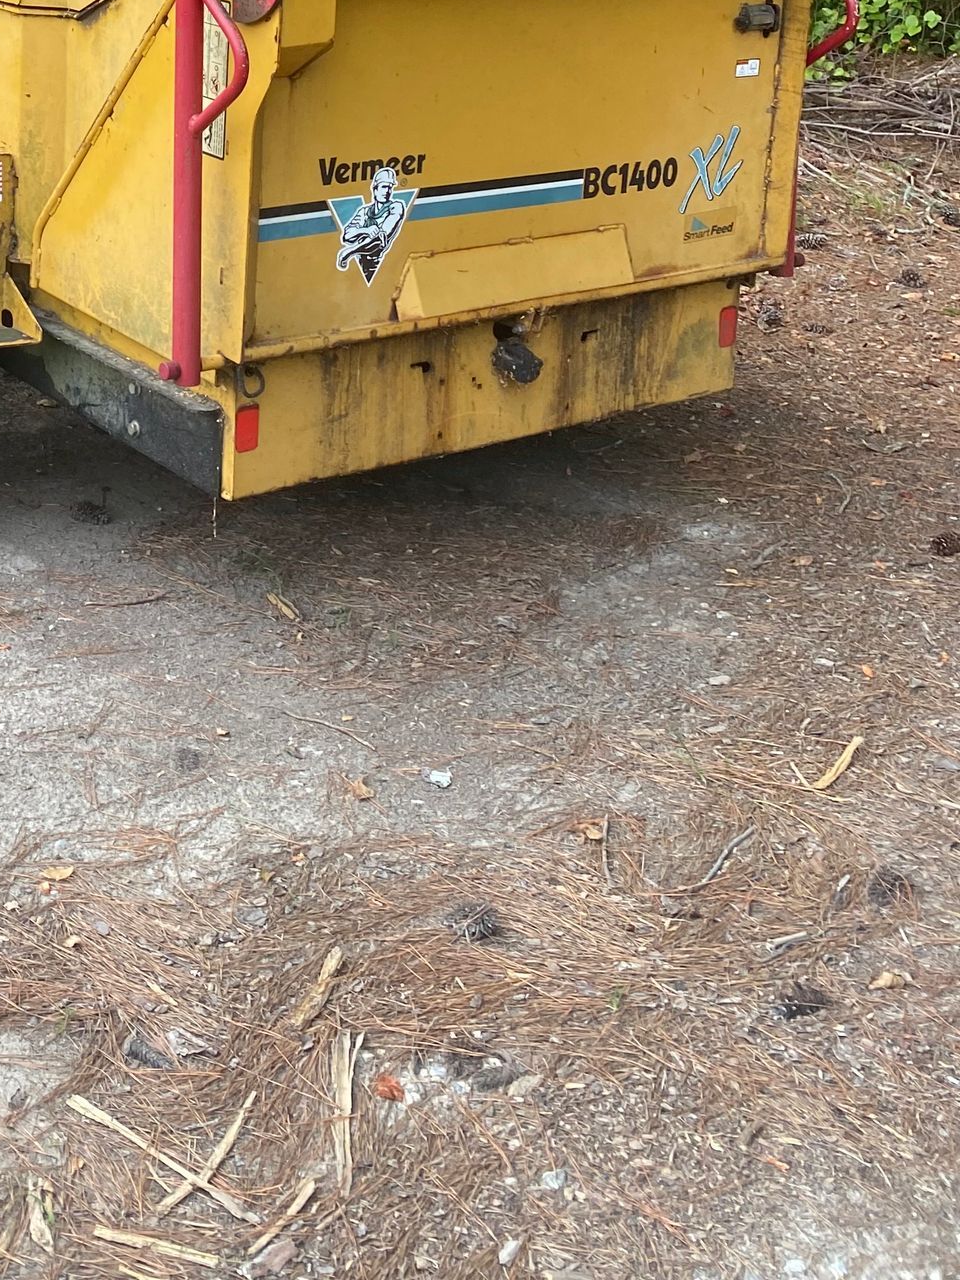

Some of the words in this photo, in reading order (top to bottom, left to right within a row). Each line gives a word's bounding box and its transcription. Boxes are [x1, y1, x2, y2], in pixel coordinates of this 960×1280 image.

[318, 153, 426, 186] Vermeer
[583, 157, 678, 200] BC1400
[678, 125, 744, 214] XL
